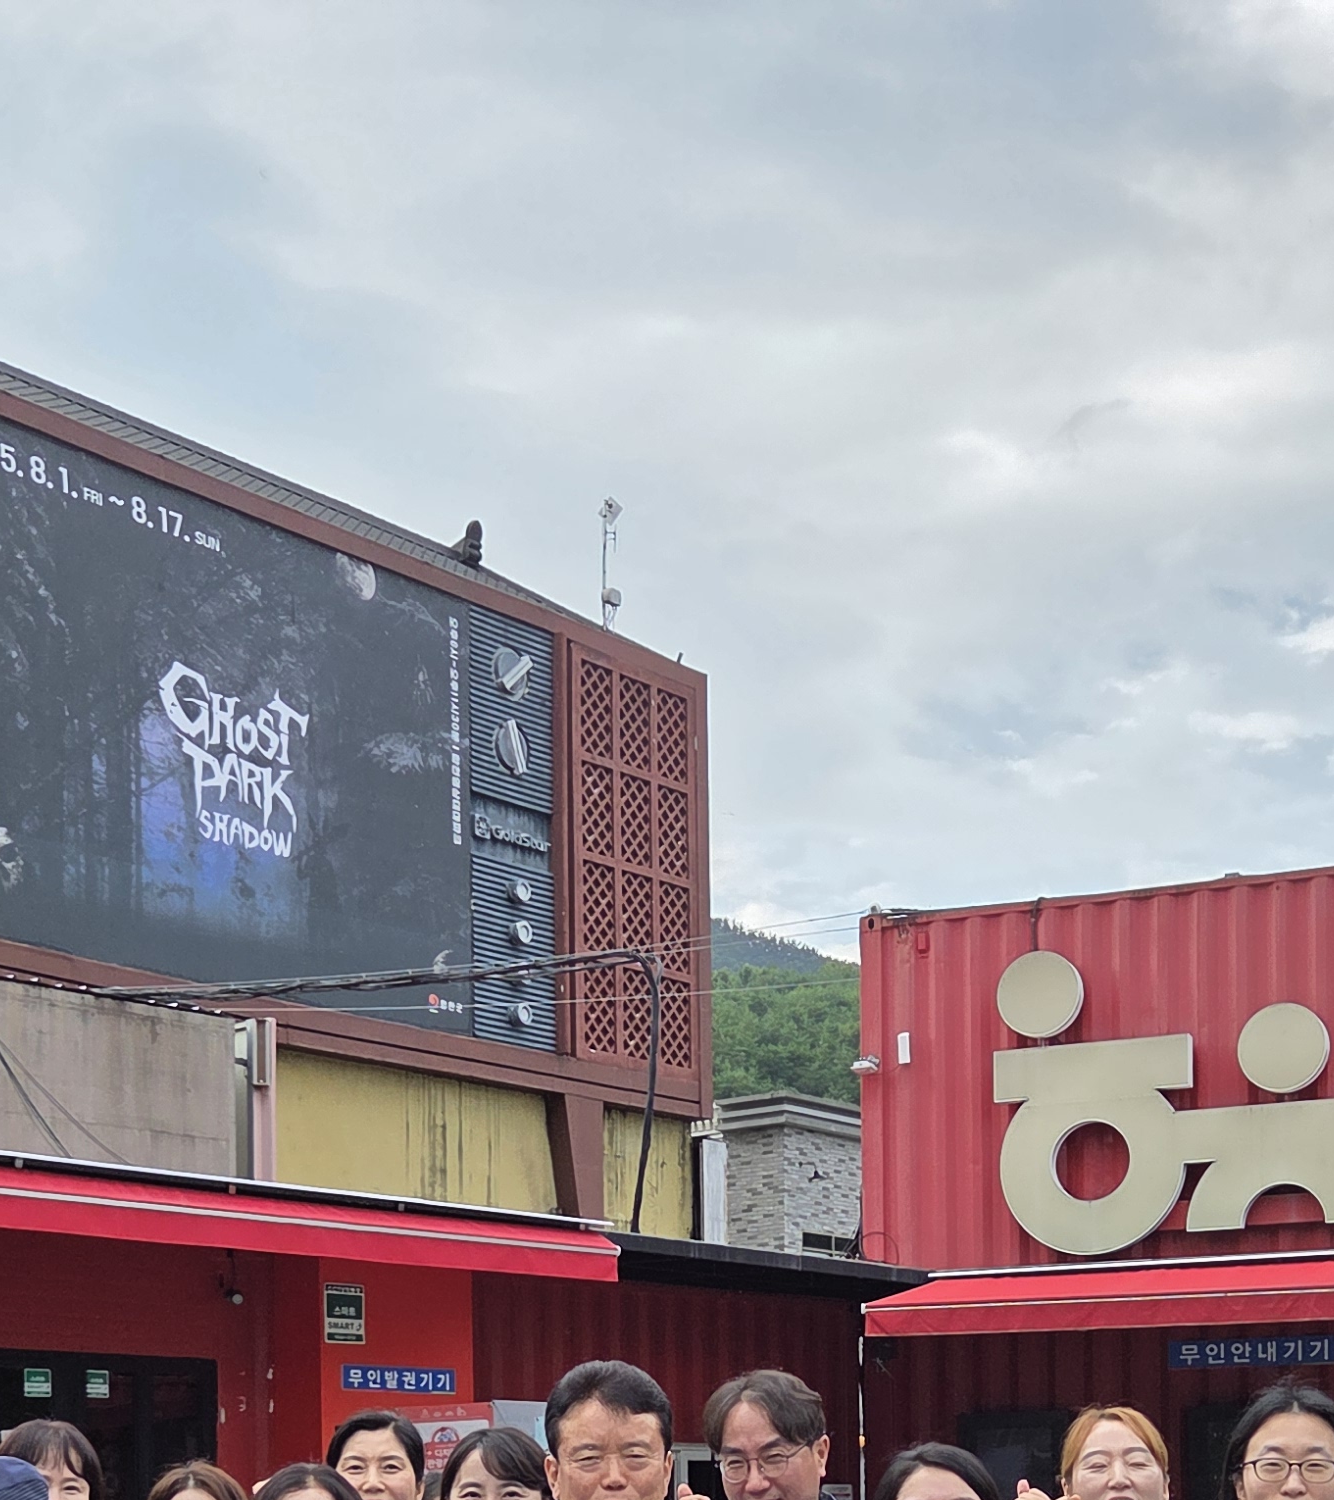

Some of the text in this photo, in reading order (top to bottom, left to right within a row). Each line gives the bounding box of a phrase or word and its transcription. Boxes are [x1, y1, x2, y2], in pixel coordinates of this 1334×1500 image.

[82, 486, 104, 507] FRI
[193, 530, 221, 553] SUN
[158, 661, 310, 766] GHOST
[176, 731, 298, 834] PARK
[199, 809, 293, 858] SHADOW
[327, 1320, 355, 1332] SMART
[1179, 1338, 1329, 1366] 무인안내기기
[347, 1368, 451, 1391] 무인발권기기
